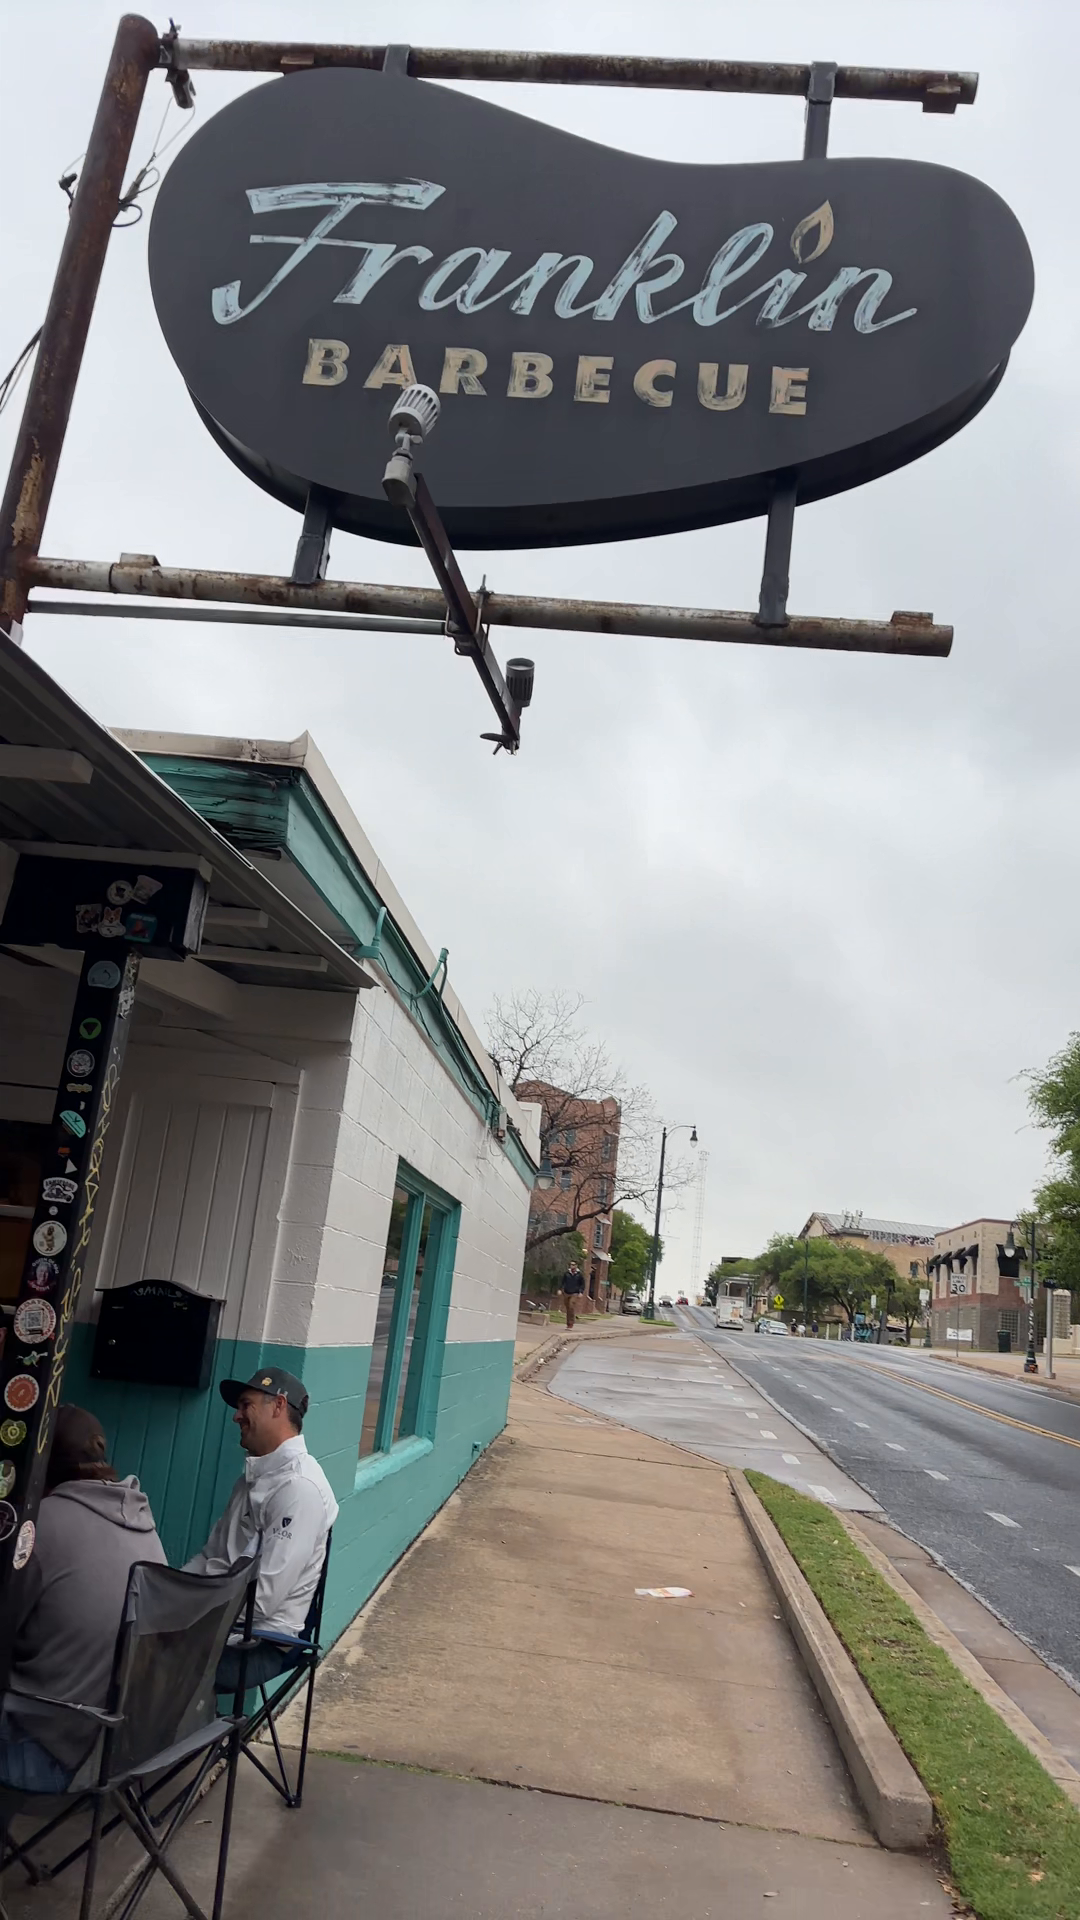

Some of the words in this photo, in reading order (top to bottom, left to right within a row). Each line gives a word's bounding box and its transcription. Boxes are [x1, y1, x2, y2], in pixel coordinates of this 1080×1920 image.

[211, 178, 918, 334] Franklin
[301, 338, 811, 416] BARBECUE
[952, 1284, 966, 1293] 30
